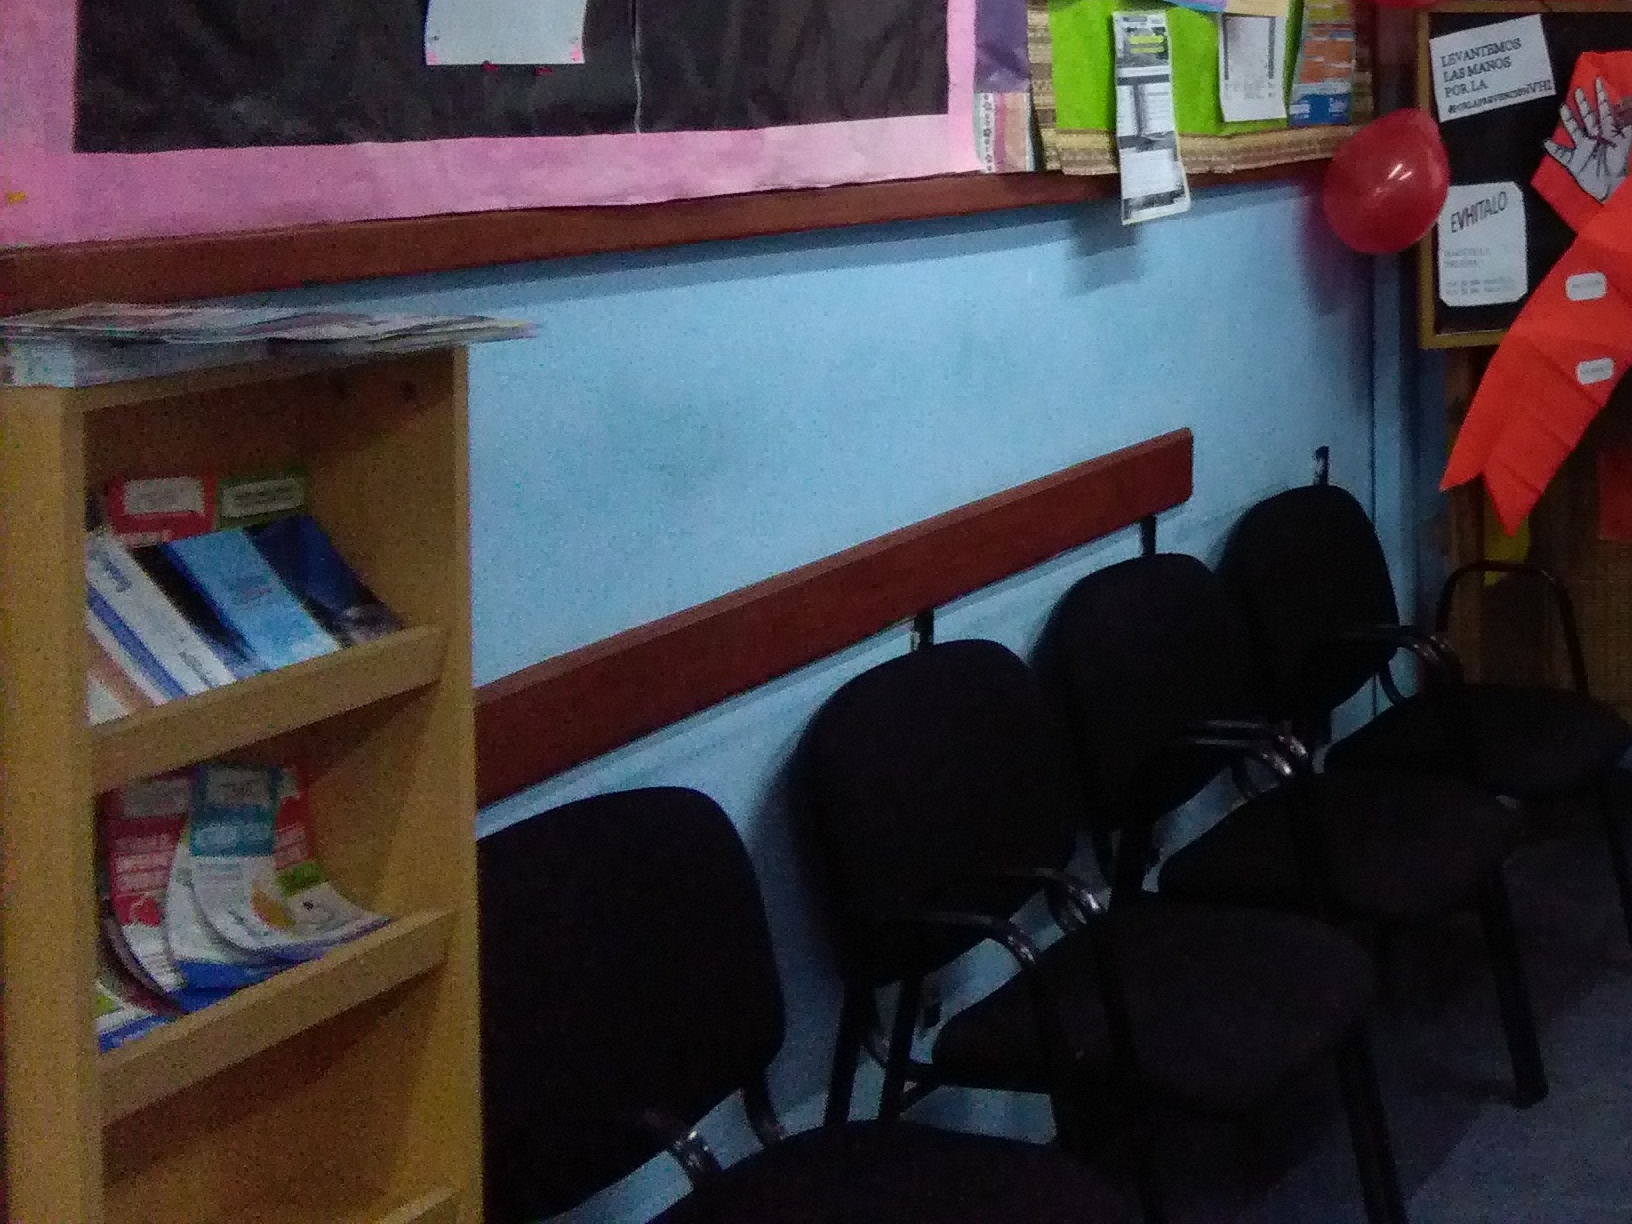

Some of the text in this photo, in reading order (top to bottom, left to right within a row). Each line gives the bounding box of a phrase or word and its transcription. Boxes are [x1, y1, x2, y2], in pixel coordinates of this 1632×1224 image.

[1440, 37, 1522, 68] LEVANTEMOS
[1443, 55, 1512, 83] LAS MANOS
[1444, 79, 1489, 98] POR LA
[1450, 191, 1509, 234] EVHITALO
